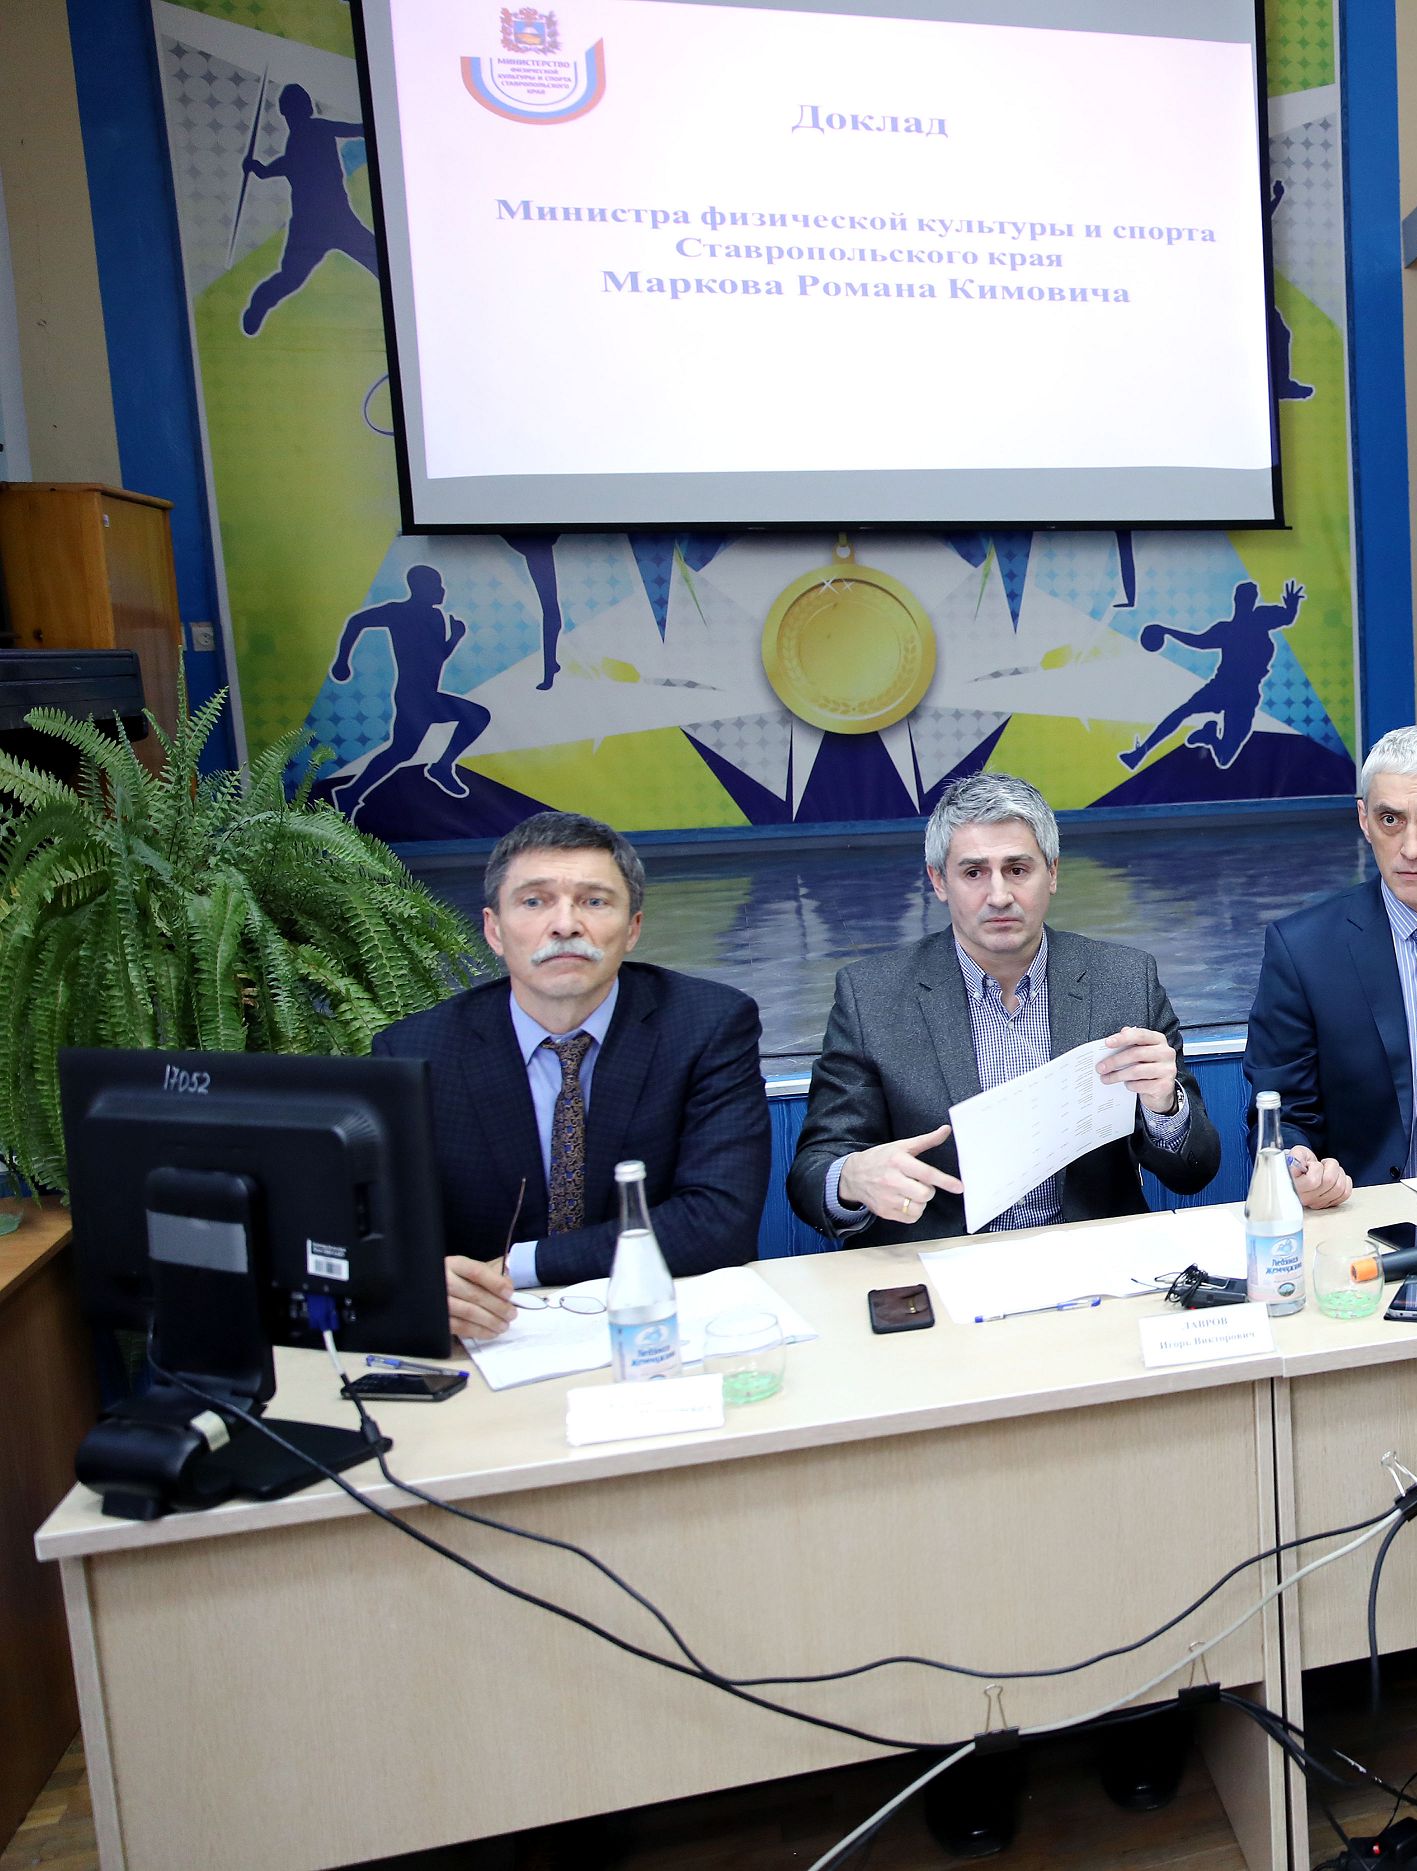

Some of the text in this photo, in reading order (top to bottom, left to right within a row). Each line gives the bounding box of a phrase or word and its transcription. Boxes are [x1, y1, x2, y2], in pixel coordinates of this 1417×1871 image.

[497, 58, 570, 68] МИНИСТЕРСТВО
[791, 104, 949, 139] Доклад
[494, 198, 1217, 245] Министра физической культуры и спорта
[675, 237, 1063, 271] Ставропольского края
[600, 270, 1131, 303] Маркова Романа Кимовича
[163, 1063, 211, 1095] 17052
